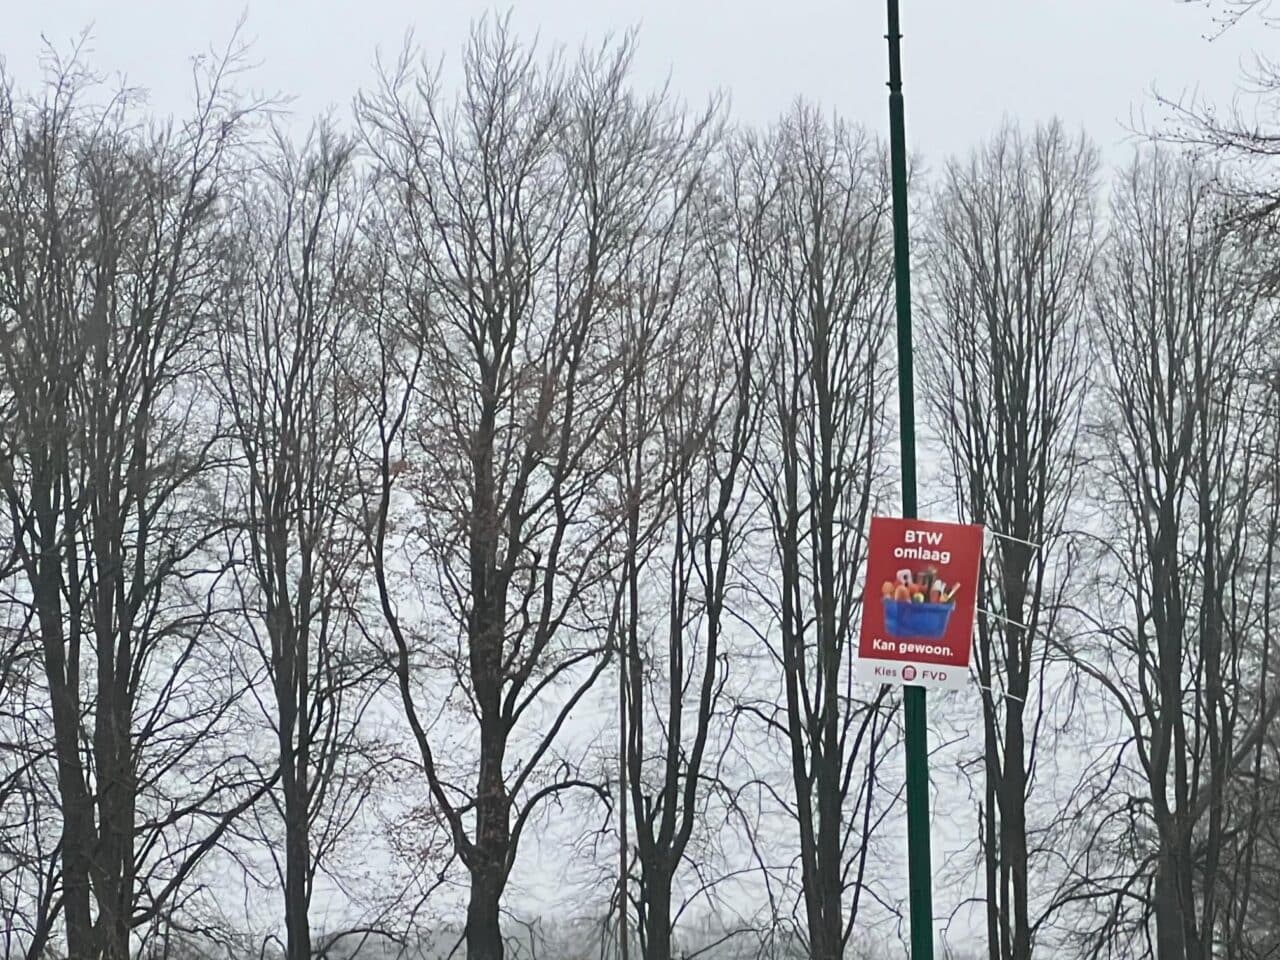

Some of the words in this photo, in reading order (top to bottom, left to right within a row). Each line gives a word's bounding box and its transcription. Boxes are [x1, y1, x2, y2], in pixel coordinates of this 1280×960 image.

[904, 530, 943, 545] BTW
[893, 546, 951, 565] omlaag
[873, 639, 896, 651] Kan
[899, 642, 954, 656] gewoon.
[874, 667, 897, 677] Kies
[922, 670, 947, 681] FVD
